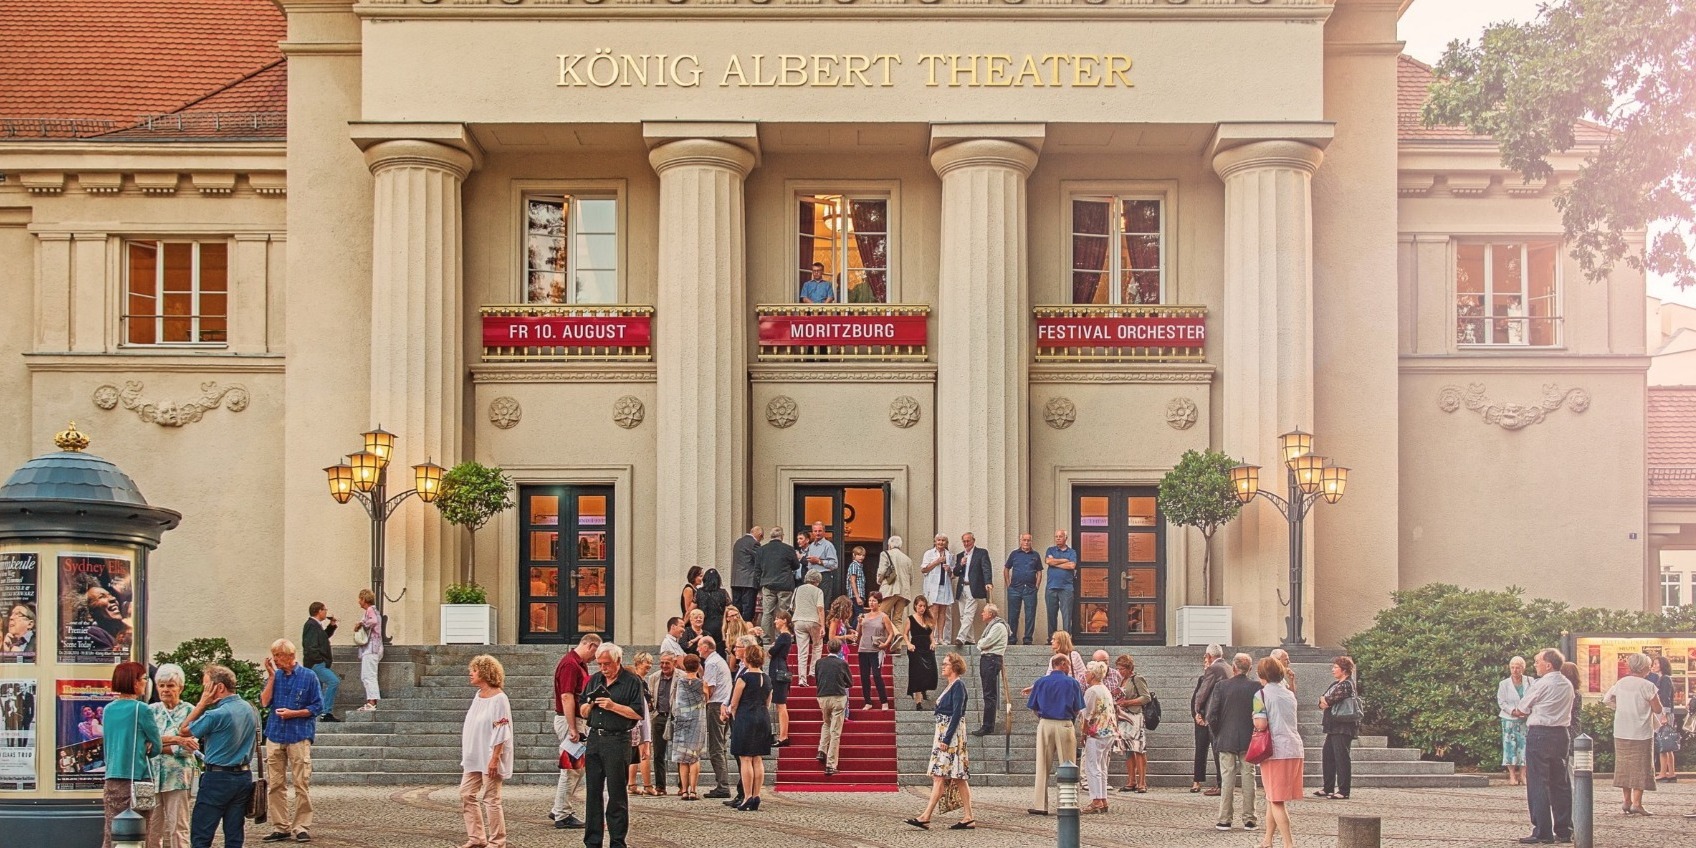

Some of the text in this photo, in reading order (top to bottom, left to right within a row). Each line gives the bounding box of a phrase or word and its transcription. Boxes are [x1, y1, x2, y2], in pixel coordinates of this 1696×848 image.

[556, 47, 1135, 88] KÖNIG ALBERT THEATER
[509, 324, 627, 339] FR 10. AUGUST
[790, 323, 895, 339] MORITZBURG
[1038, 324, 1205, 339] FESTIVAL ORCHESTER
[64, 558, 105, 577] Sydney
